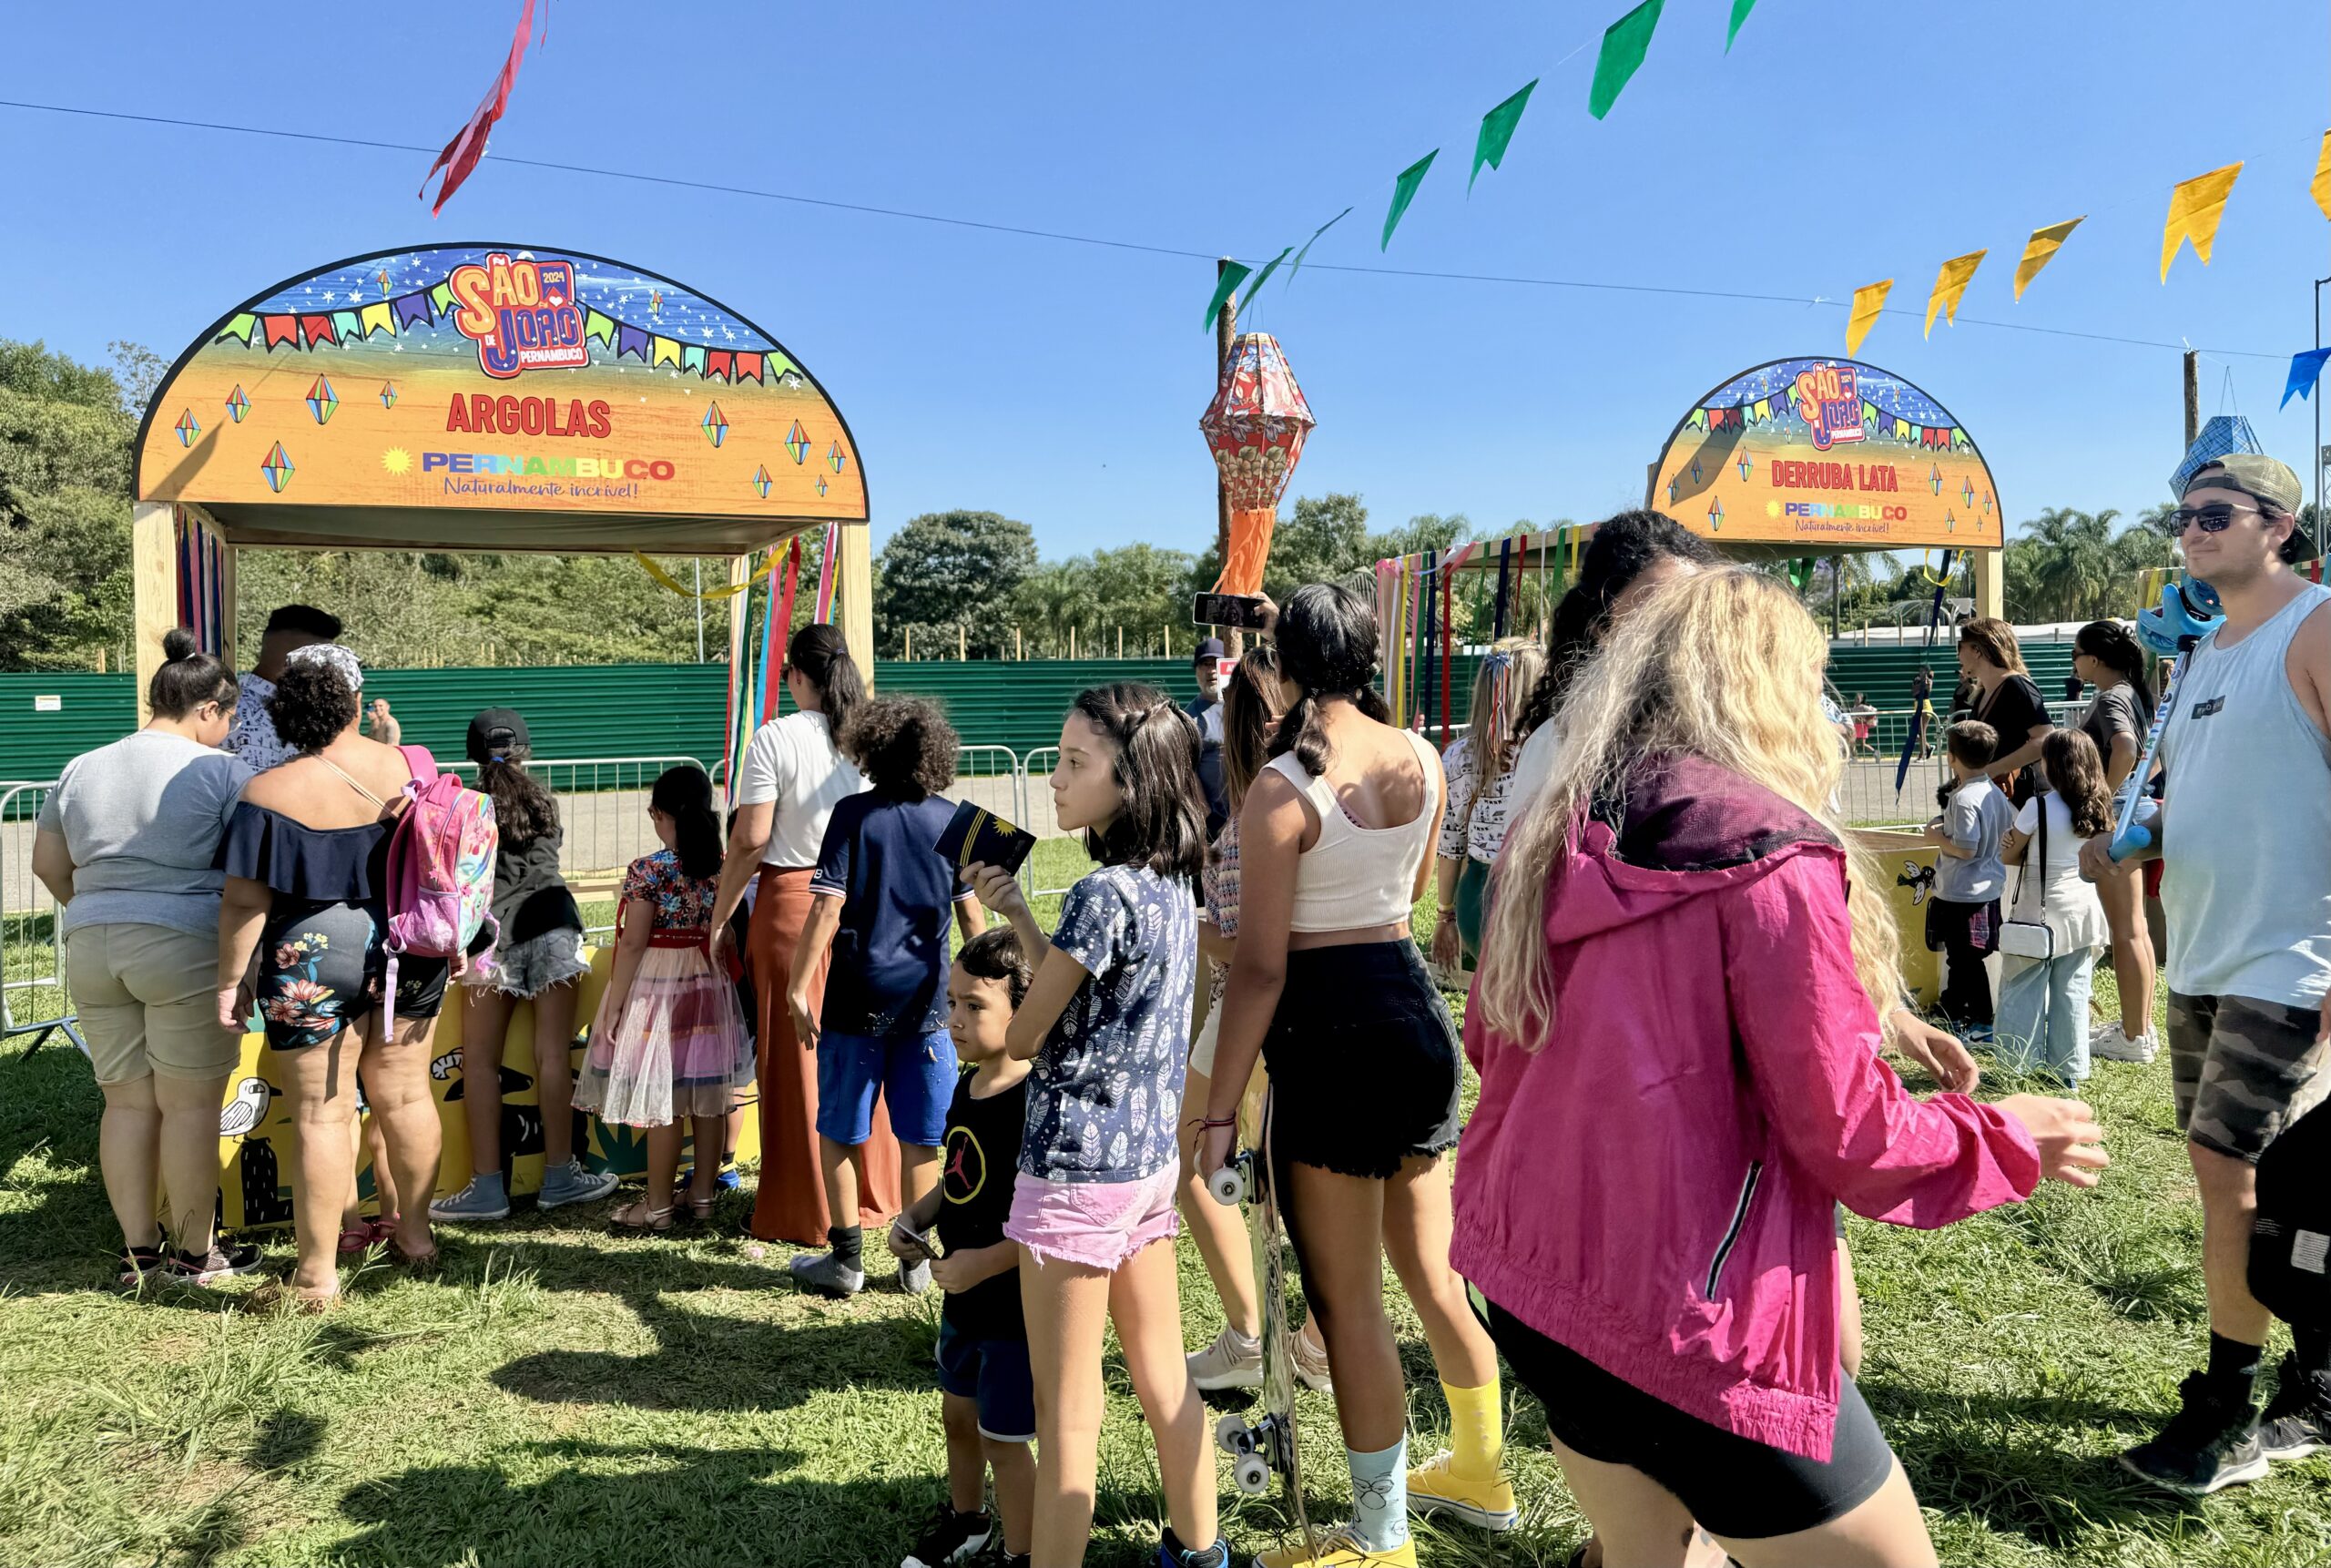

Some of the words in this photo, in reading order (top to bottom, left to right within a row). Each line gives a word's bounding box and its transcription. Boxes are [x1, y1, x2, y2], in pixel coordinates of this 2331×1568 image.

[543, 271, 565, 283] 2024
[456, 257, 539, 334] SÃO
[484, 335, 496, 346] DE
[485, 301, 580, 372] JOÃO
[520, 347, 584, 363] PERNAMBUCO
[1798, 366, 1839, 419] SÃO
[446, 393, 611, 438] ARGOLAS
[422, 453, 676, 481] PERNAMBUCO
[1771, 460, 1854, 490] DERRUBA
[1858, 464, 1898, 492] LATA
[444, 476, 565, 497] Naturalmente
[1785, 502, 1908, 521] PERNAMBUCO
[1795, 519, 1854, 533] Naturalmente
